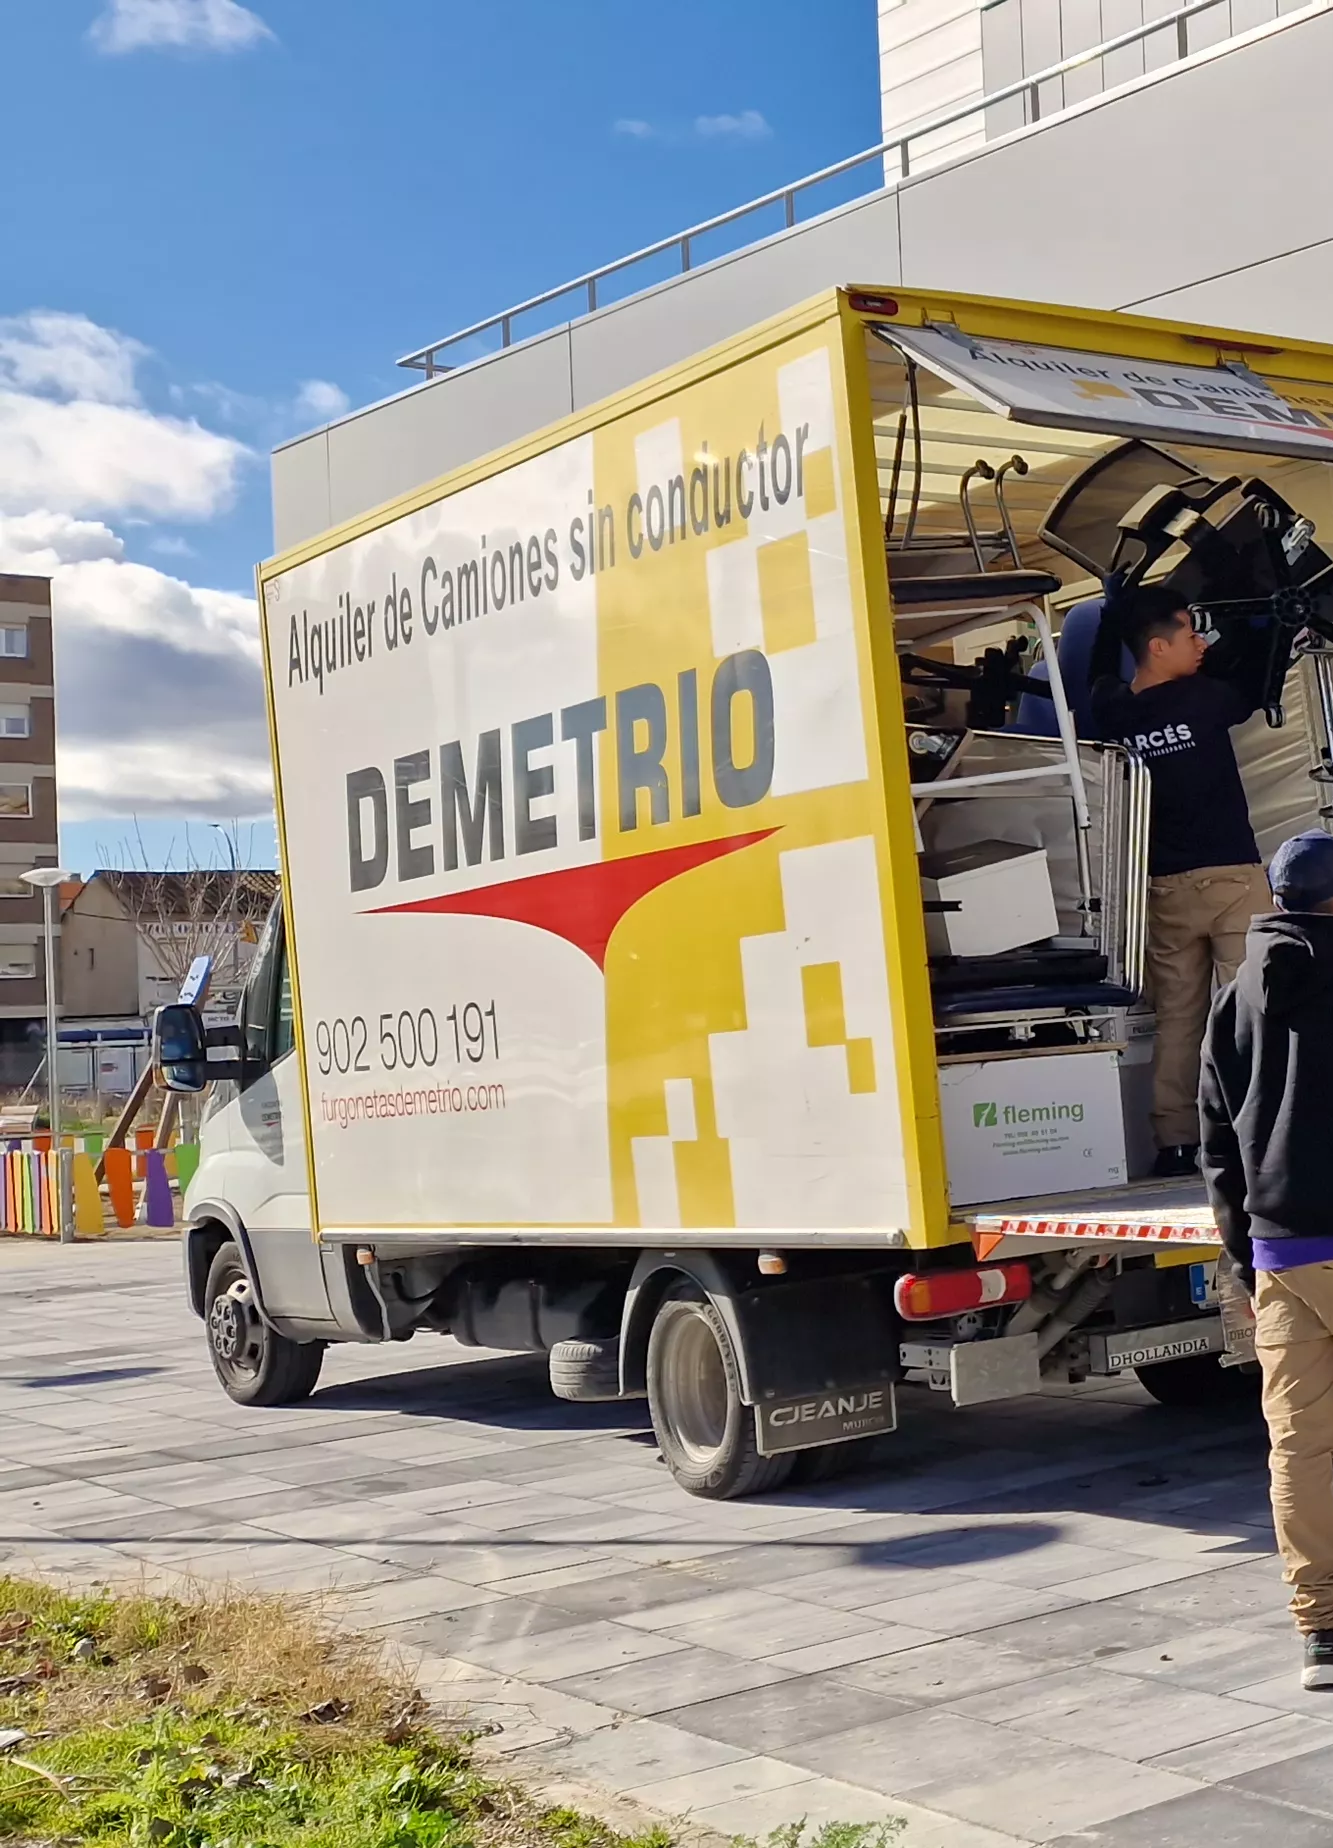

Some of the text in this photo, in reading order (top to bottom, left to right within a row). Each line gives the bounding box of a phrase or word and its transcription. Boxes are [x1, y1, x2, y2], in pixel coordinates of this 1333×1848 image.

[1123, 370, 1167, 387] de
[287, 419, 812, 697] Alquiler de Camiones sin conductor
[1110, 723, 1193, 752] ARCÉS
[345, 648, 777, 894] DEMETRIO
[315, 997, 501, 1076] 902 500 191
[320, 1079, 507, 1131] furgonetasdemetrio.com
[1003, 1101, 1084, 1126] fleming
[1110, 1338, 1209, 1368] DHOLLANDIA
